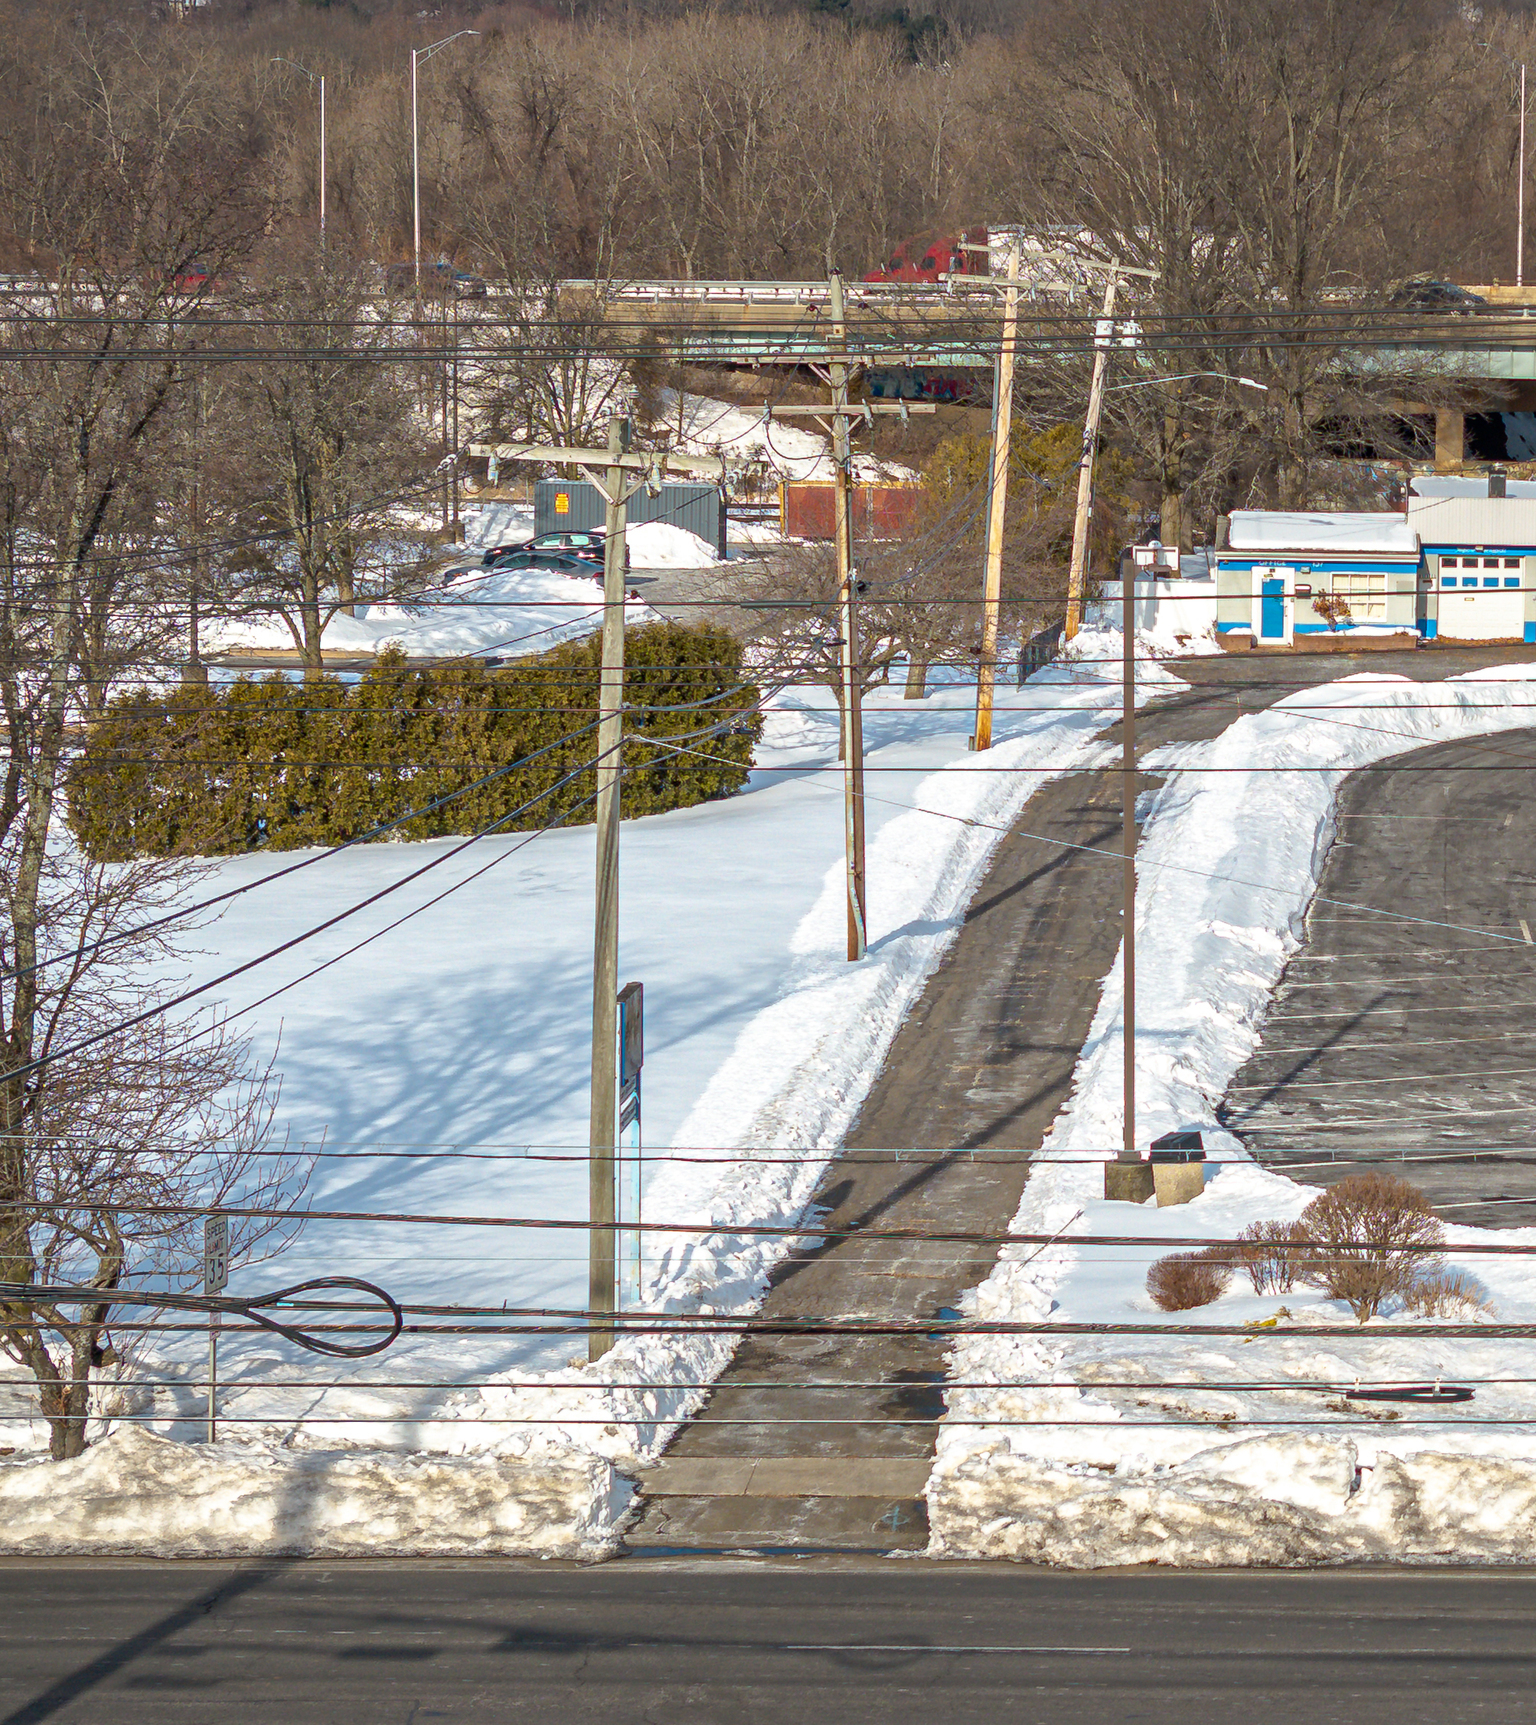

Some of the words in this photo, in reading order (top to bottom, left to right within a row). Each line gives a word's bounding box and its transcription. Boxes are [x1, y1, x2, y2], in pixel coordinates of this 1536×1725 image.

[207, 1221, 226, 1239] SPEED
[207, 1237, 224, 1254] LIMIT
[209, 1252, 224, 1284] 35
